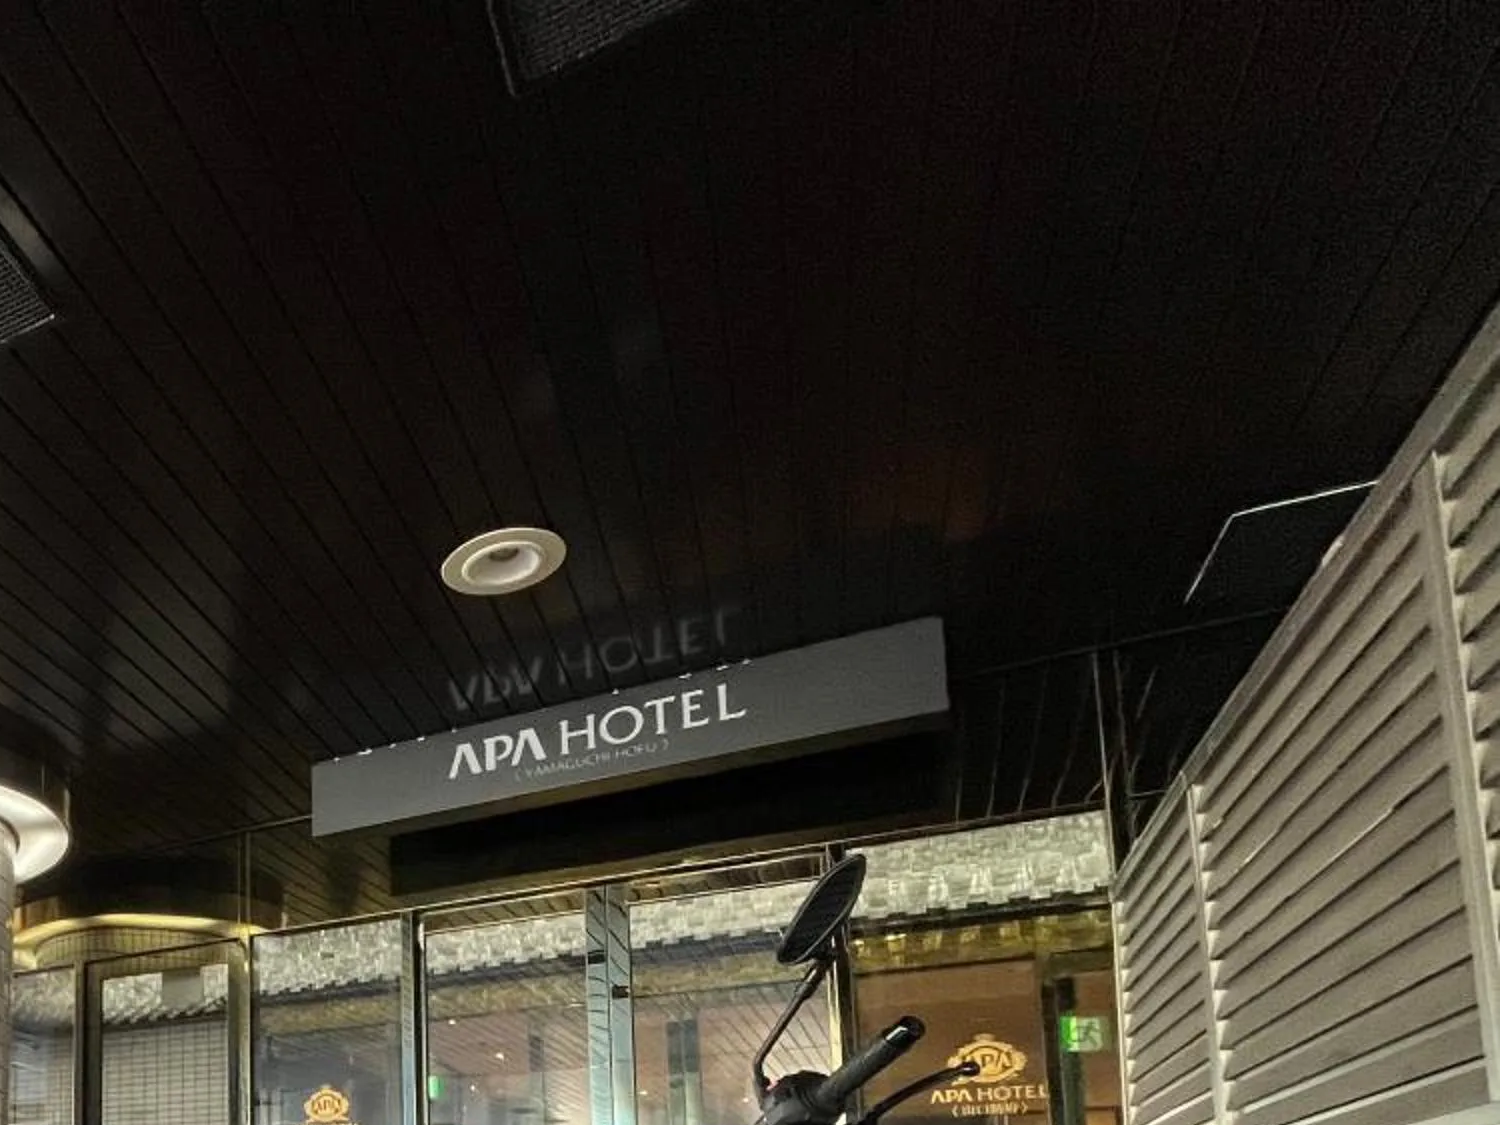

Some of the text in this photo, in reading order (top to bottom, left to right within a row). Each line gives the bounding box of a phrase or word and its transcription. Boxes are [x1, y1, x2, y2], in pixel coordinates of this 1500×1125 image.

[448, 683, 747, 779] APA HOTEL
[930, 1084, 1049, 1104] APA HOTEL
